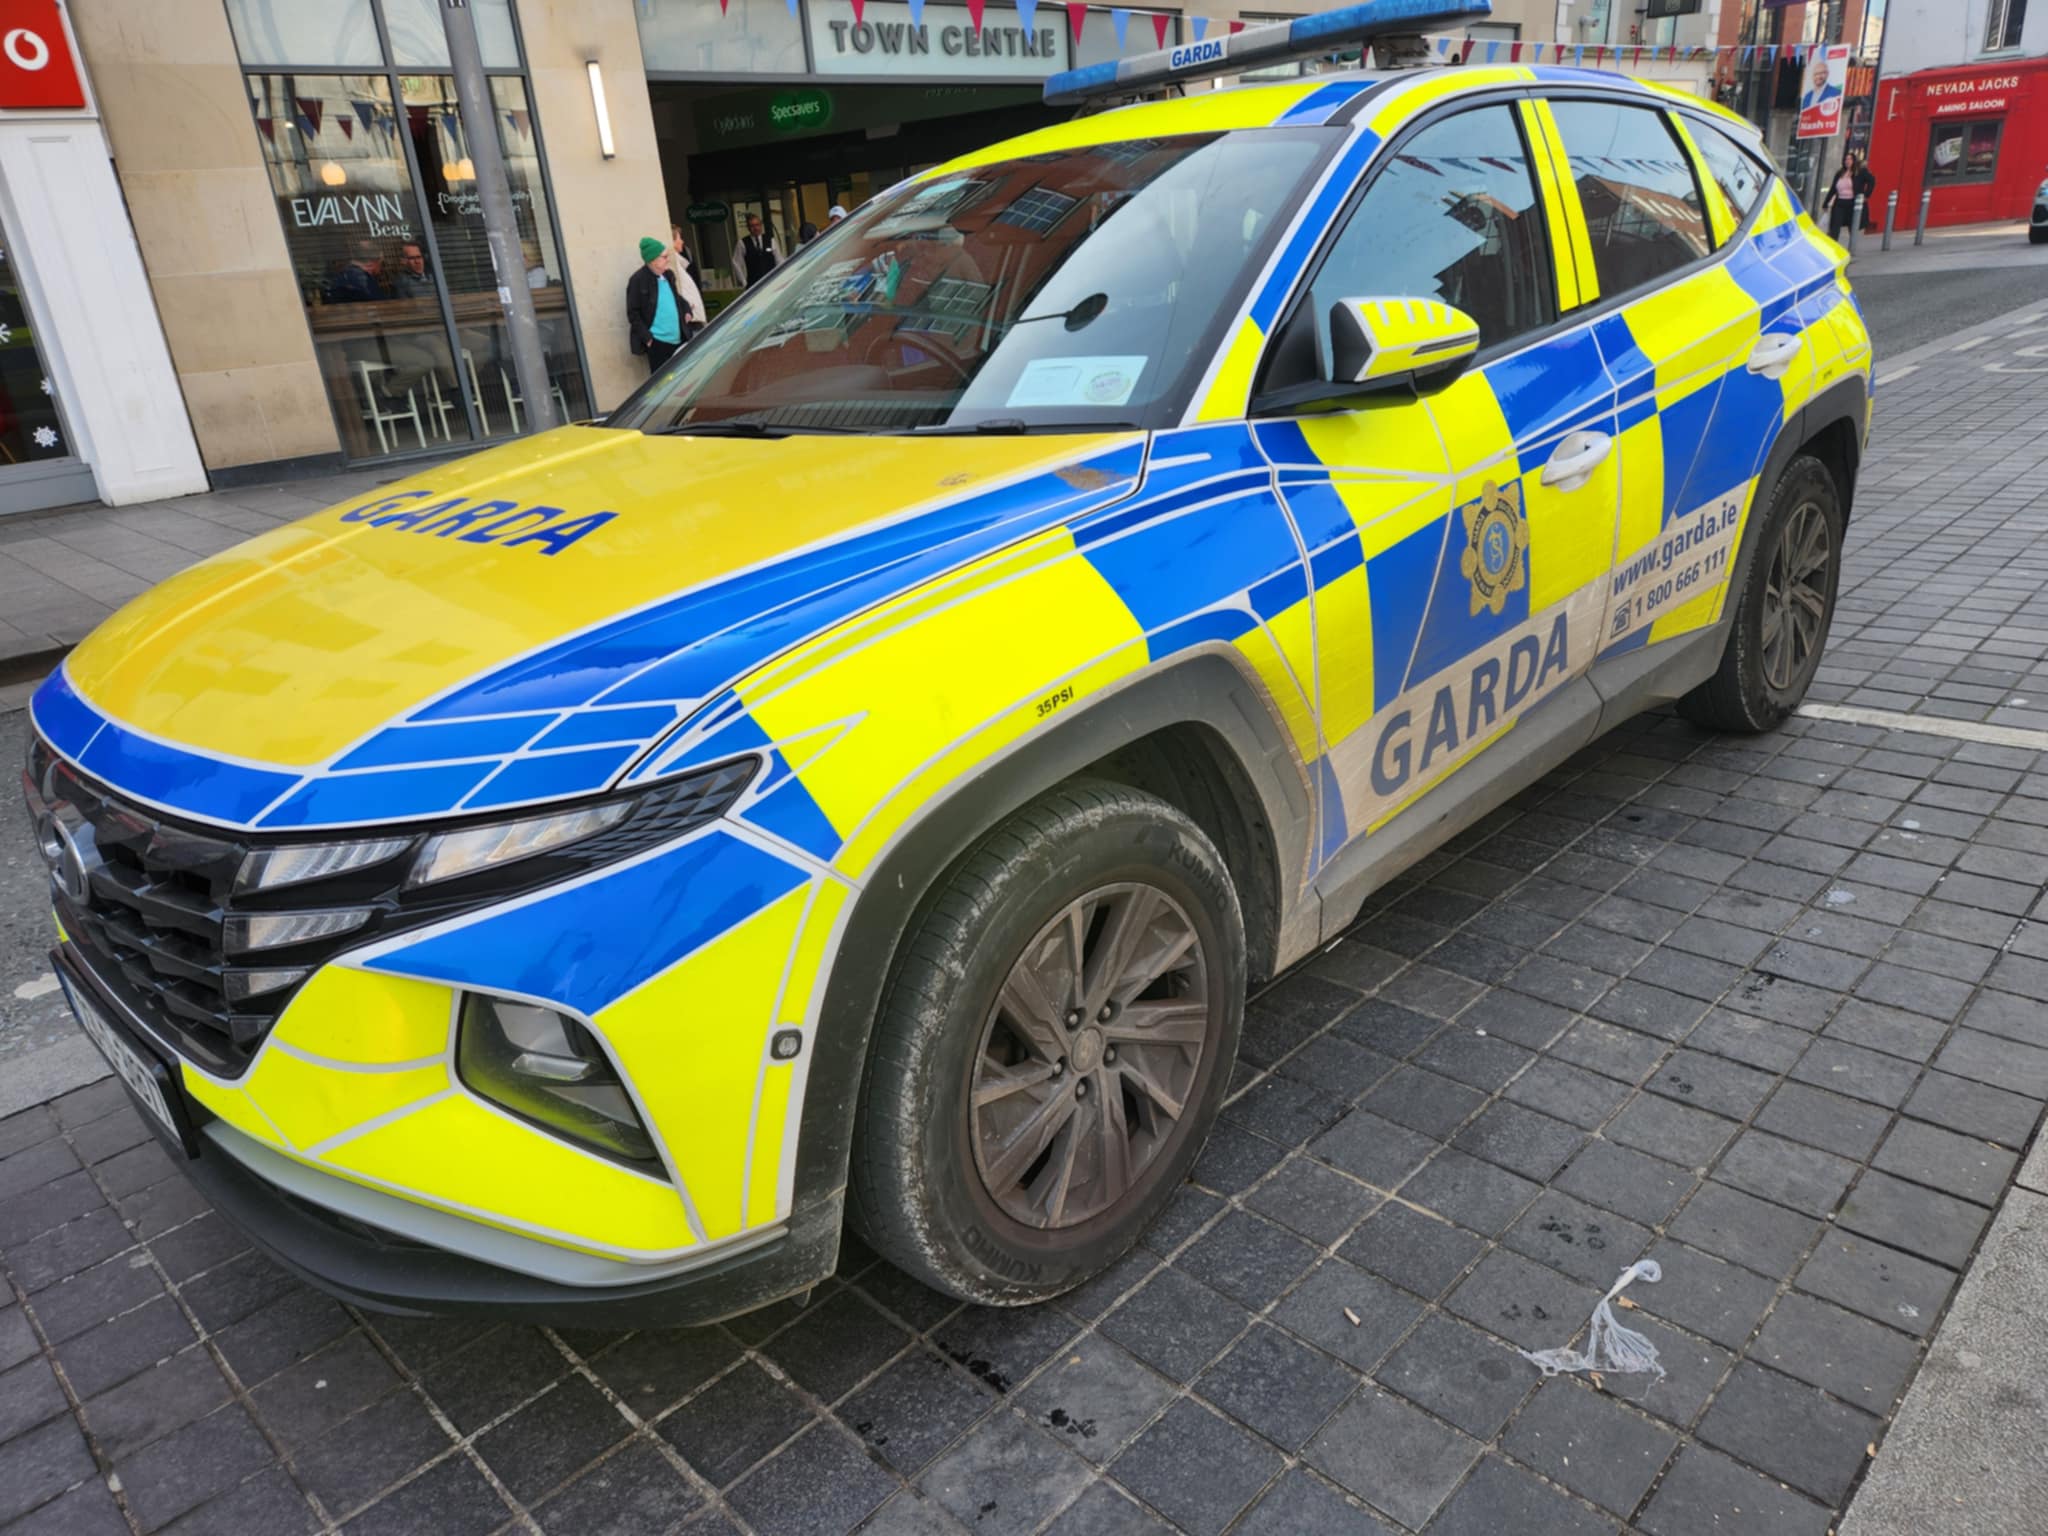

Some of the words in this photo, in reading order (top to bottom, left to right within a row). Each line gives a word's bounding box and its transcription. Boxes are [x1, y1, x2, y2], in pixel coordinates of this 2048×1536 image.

[829, 20, 929, 55] TOWN
[942, 25, 1056, 58] CENTRE
[1172, 40, 1222, 67] GARDA
[1926, 80, 1975, 96] NEVADA
[1978, 76, 2019, 91] JACKS
[771, 101, 820, 122] Specsavers
[1969, 98, 2006, 110] SALOON
[291, 193, 404, 227] EVALYNN
[368, 220, 412, 241] Beag
[339, 490, 620, 557] GARDA
[1613, 501, 1737, 597] www.garda.ie
[1635, 597, 1643, 617] 1
[1646, 580, 1673, 611] 800
[1675, 561, 1701, 592] 666
[1704, 545, 1726, 574] 111
[1036, 685, 1075, 718] 35PSI
[1370, 611, 1568, 796] GARDA
